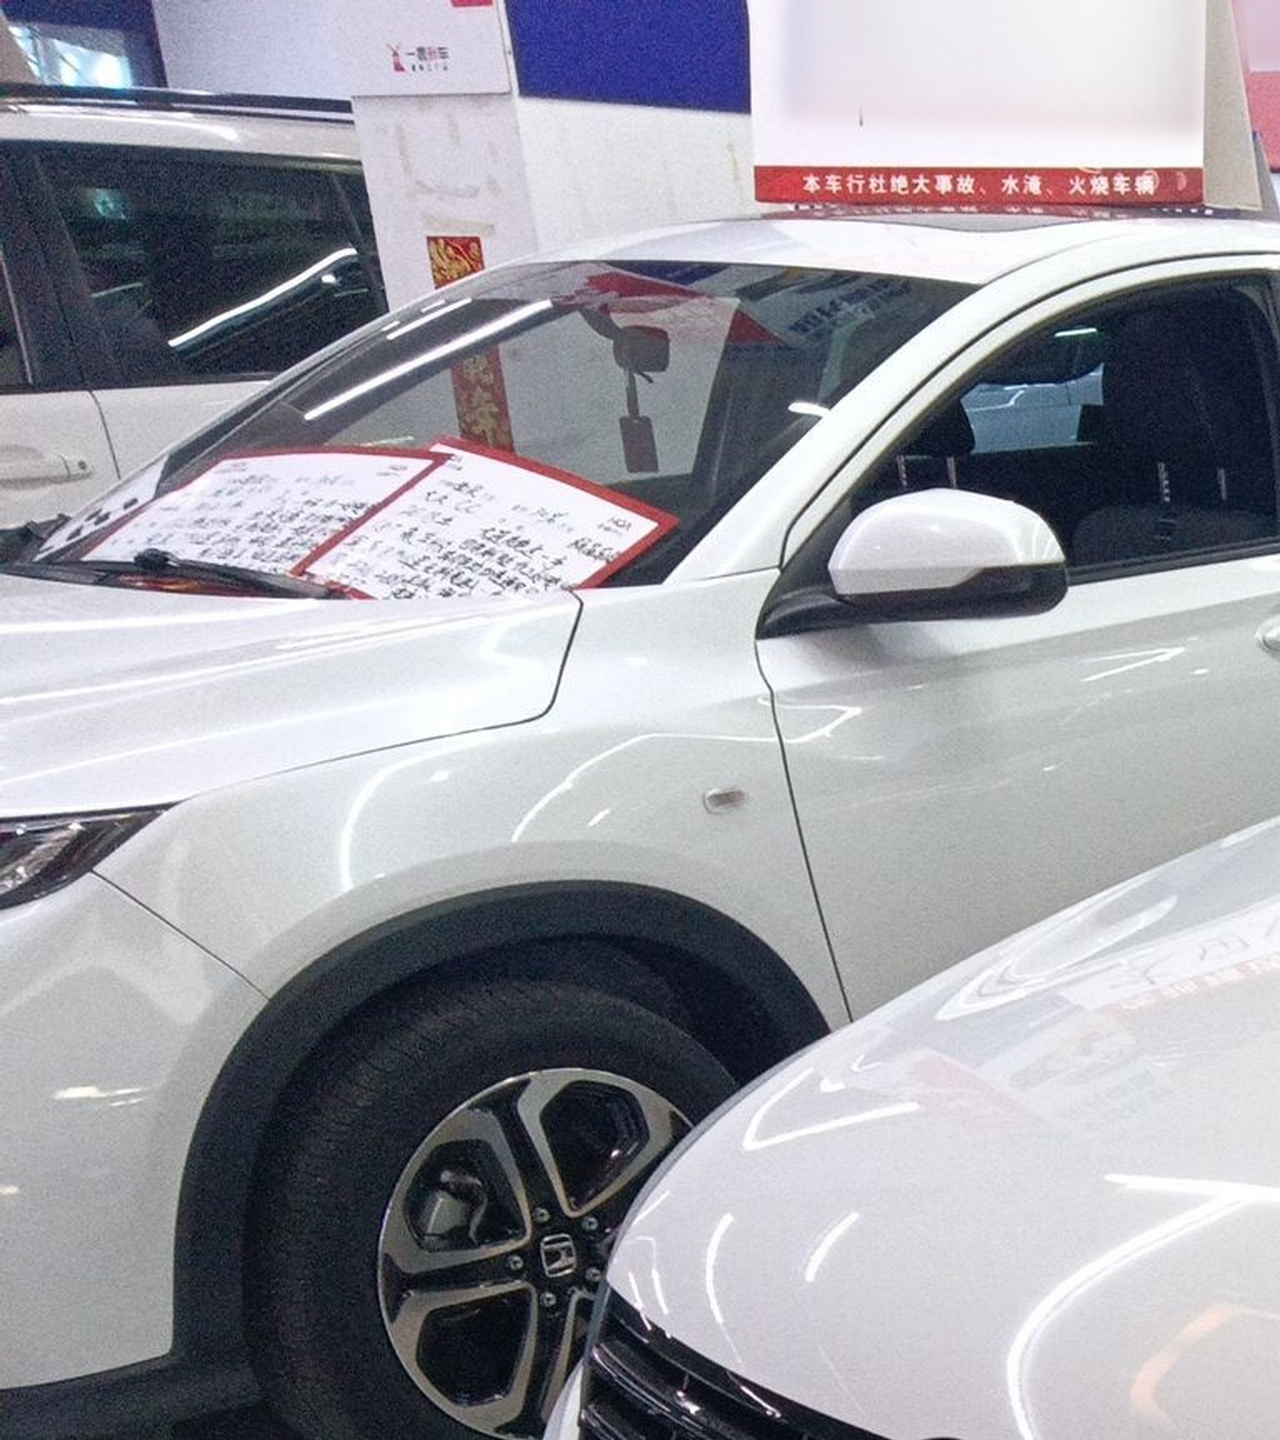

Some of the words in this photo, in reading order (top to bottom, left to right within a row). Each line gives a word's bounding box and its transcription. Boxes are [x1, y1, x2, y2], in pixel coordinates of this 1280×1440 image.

[802, 173, 1156, 196] 本车行杜绝大事故、水淹、火烧车辆
